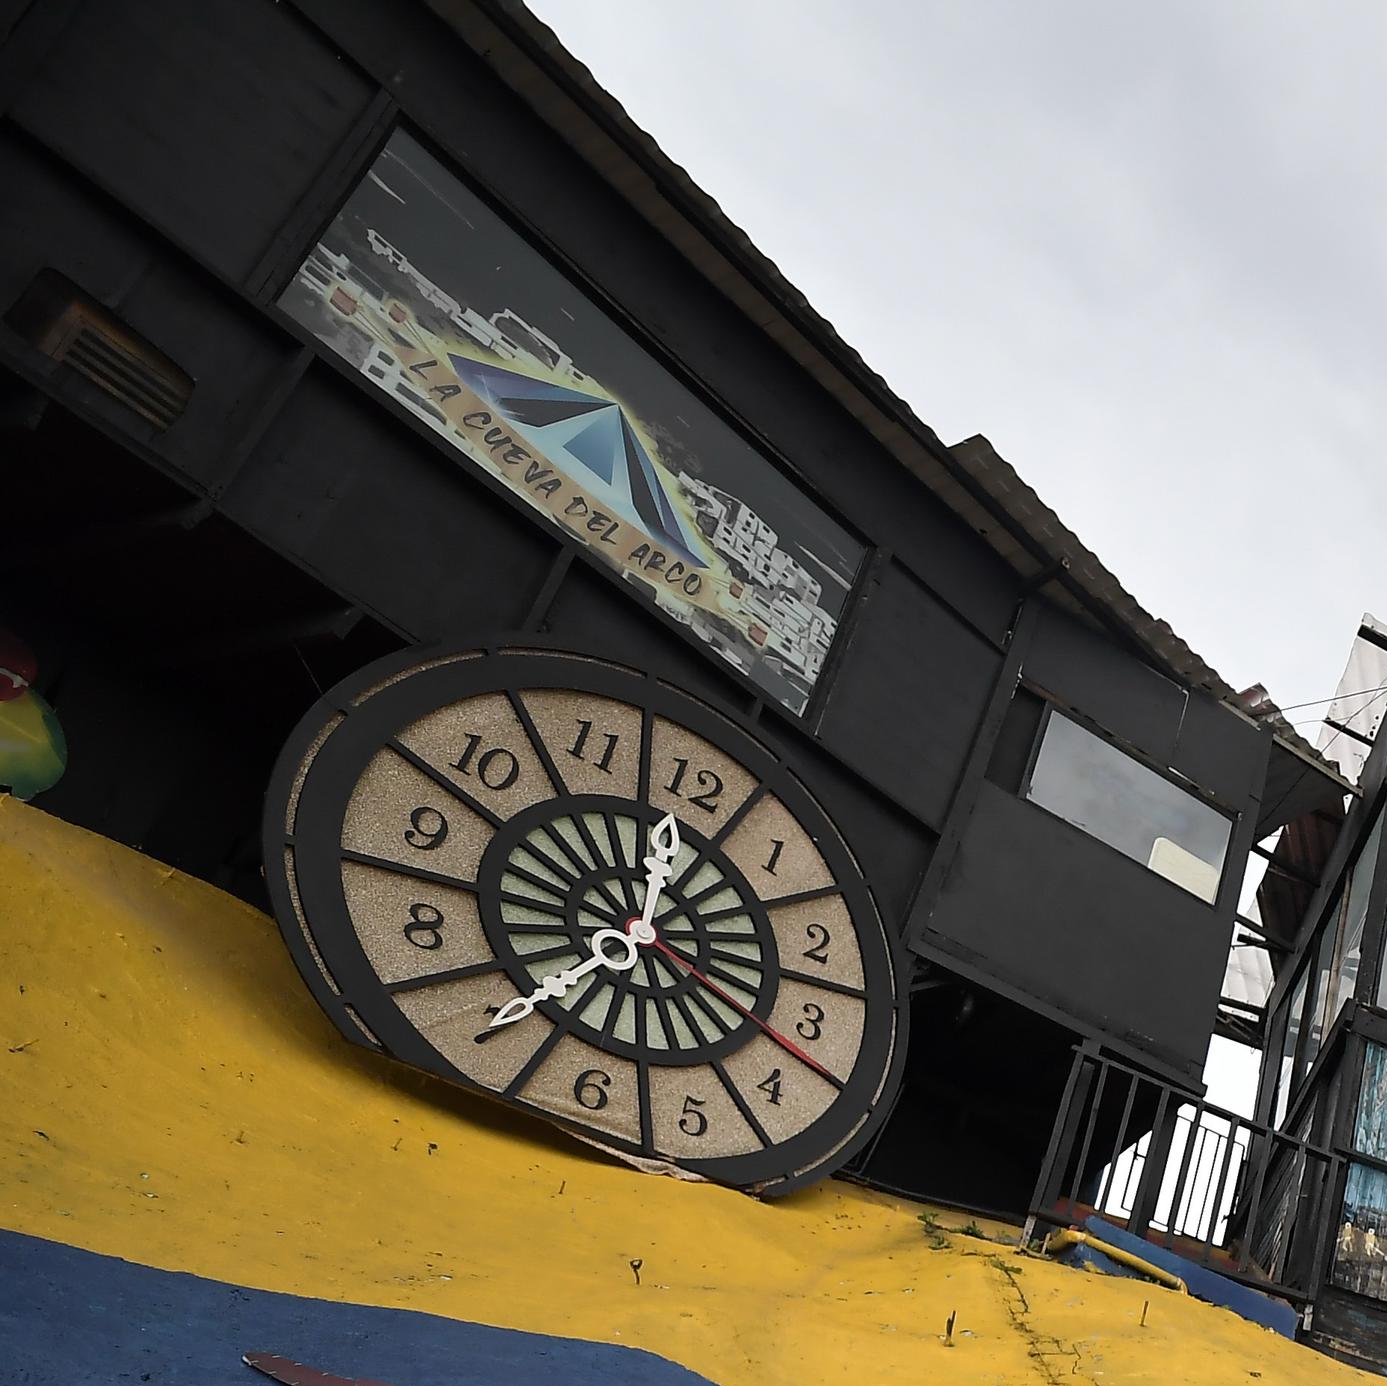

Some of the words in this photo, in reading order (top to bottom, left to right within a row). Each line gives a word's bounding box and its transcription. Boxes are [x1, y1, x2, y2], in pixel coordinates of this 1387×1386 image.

[408, 359, 461, 403] LA
[462, 410, 561, 499] CUEVA
[564, 495, 619, 547] DEL
[629, 542, 702, 596] ARCO
[448, 733, 520, 791] 10
[566, 719, 620, 774] 11
[662, 757, 724, 814] 12
[404, 806, 449, 850] 9
[761, 838, 785, 876] 1
[403, 903, 445, 950] 8
[803, 923, 831, 964] 2
[797, 1003, 825, 1041] 3
[573, 1069, 612, 1111] 6
[758, 1068, 784, 1105] 4
[678, 1096, 708, 1137] 5
